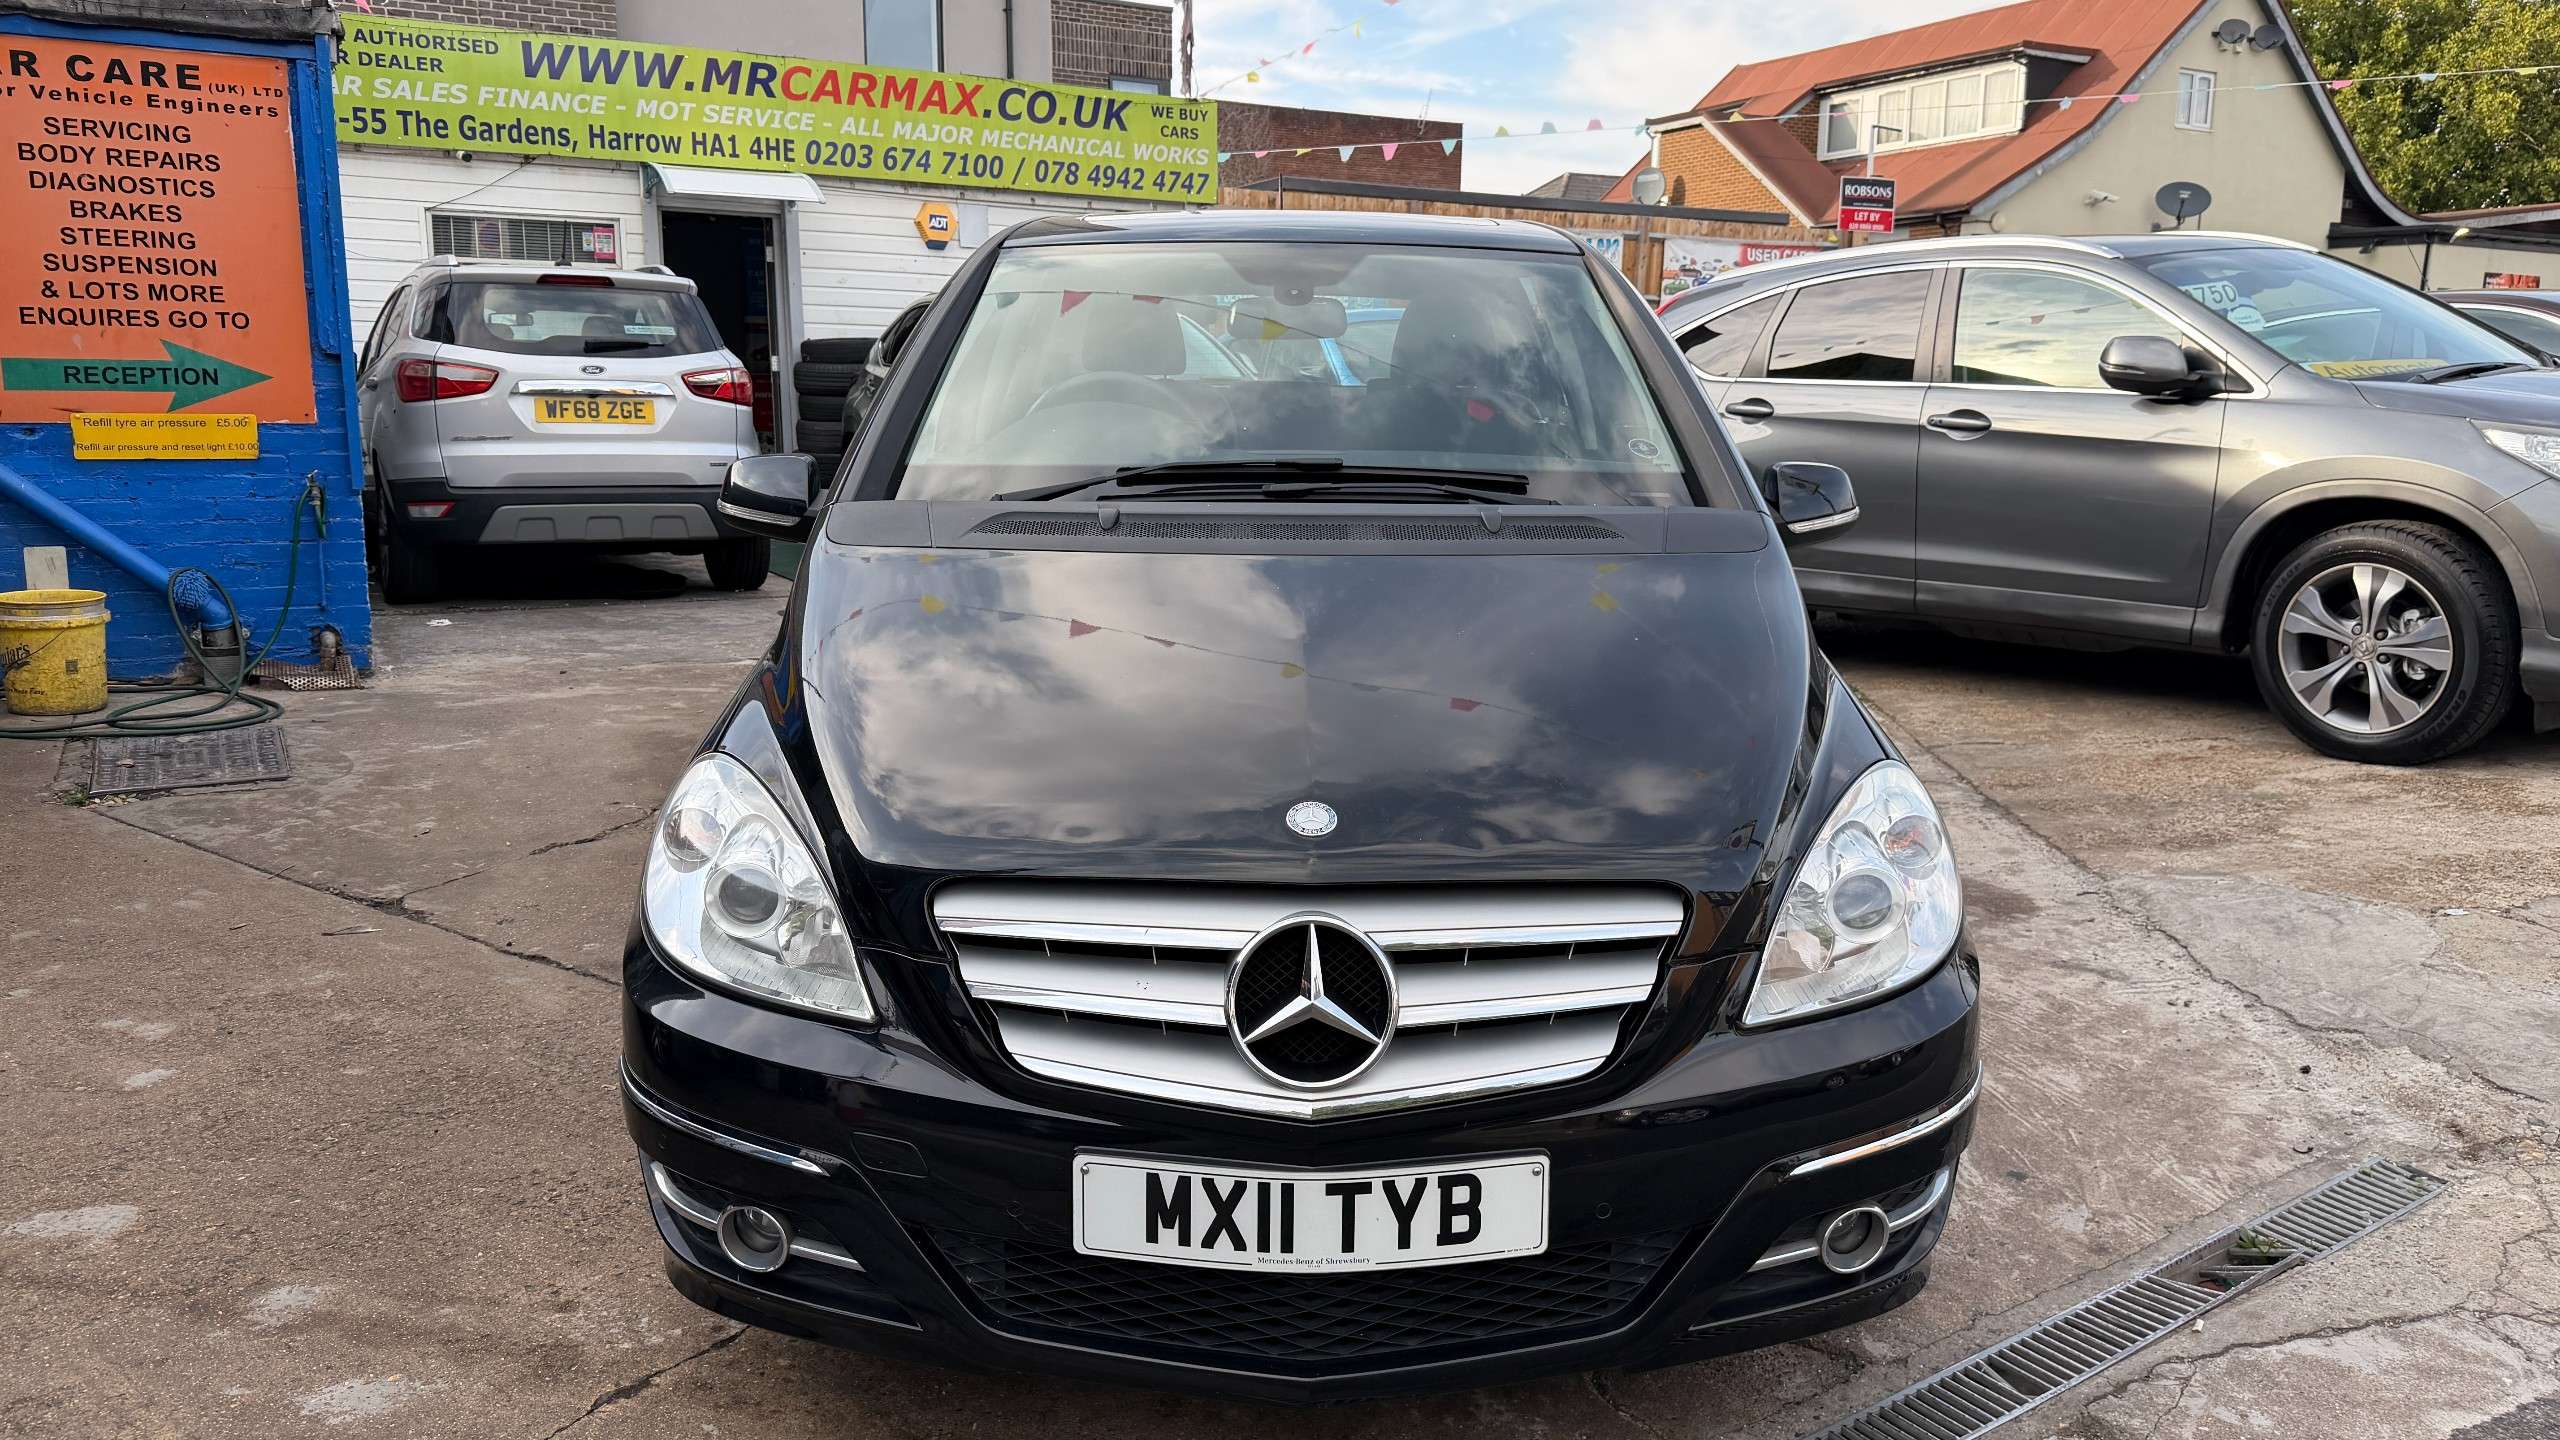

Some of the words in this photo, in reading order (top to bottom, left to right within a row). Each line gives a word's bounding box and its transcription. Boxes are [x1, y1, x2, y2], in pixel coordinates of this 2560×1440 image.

[353, 28, 499, 55] AUTHORISED
[0, 49, 40, 78] R
[66, 54, 202, 91] CARE
[208, 82, 245, 97] (UK)
[253, 86, 283, 98] LTD
[358, 52, 444, 72] DEALER
[520, 40, 1133, 132] WWW.MRCARMAX.CO.UK
[29, 84, 133, 106] Vehicle
[146, 93, 279, 118] Engineers
[372, 77, 468, 105] SALES
[477, 86, 606, 115] FINANCE
[635, 101, 696, 124] MOT
[703, 104, 813, 133] SERVICE
[839, 117, 884, 139] ALL
[893, 121, 973, 146] MAJOR
[980, 129, 1125, 160] MECHANICAL
[1134, 142, 1210, 167] WORKS
[1151, 105, 1173, 120] WE
[1177, 107, 1209, 122] BUY
[43, 116, 191, 144] SERVICING
[1160, 125, 1200, 140] CARS
[17, 142, 95, 165] BODY
[106, 148, 221, 172] REPAIRS
[396, 110, 449, 139] The
[458, 114, 579, 153] Gardens,
[588, 125, 682, 156] Harrow
[691, 131, 740, 159] HA1
[749, 136, 796, 164] 4HE
[804, 140, 873, 169] 0203
[883, 146, 932, 172] 674
[941, 151, 1003, 180] 7100
[1035, 159, 1079, 185] 078
[1087, 165, 1145, 191] 4942
[1153, 170, 1210, 196] 4747
[29, 171, 216, 198] DIAGNOSTICS
[1845, 184, 1892, 199] ROBSONS
[70, 200, 182, 223] BRAKES
[930, 217, 947, 229] ADT
[1854, 211, 1869, 221] LET
[1870, 212, 1880, 222] BY
[60, 227, 197, 250] STEERING
[43, 253, 218, 277] SUSPENSION
[1747, 247, 1780, 262] USED
[41, 282, 59, 299] &
[69, 282, 139, 301] LOTS
[149, 284, 225, 303] MORE
[19, 306, 160, 329] ENQUIRES
[168, 311, 207, 330] GO
[218, 312, 250, 331] TO
[64, 365, 219, 386] RECEPTION
[545, 400, 600, 419] WF68
[606, 401, 646, 419] ZGE
[83, 417, 112, 428] Refill
[115, 418, 137, 429] tyre
[140, 418, 154, 427] air
[158, 419, 206, 429] pressure
[216, 417, 248, 428] £5.00
[77, 443, 100, 451] Refill
[103, 443, 115, 451] air
[117, 443, 159, 453] pressure
[161, 443, 178, 451] and
[181, 443, 204, 451] reset
[207, 442, 226, 453] light
[1145, 1172, 1295, 1254] MX11
[1325, 1173, 1482, 1254] TYB
[1257, 1256, 1314, 1265] Mercedes-Benz
[1316, 1257, 1324, 1265] of
[1325, 1257, 1371, 1266] Shrewsbury
